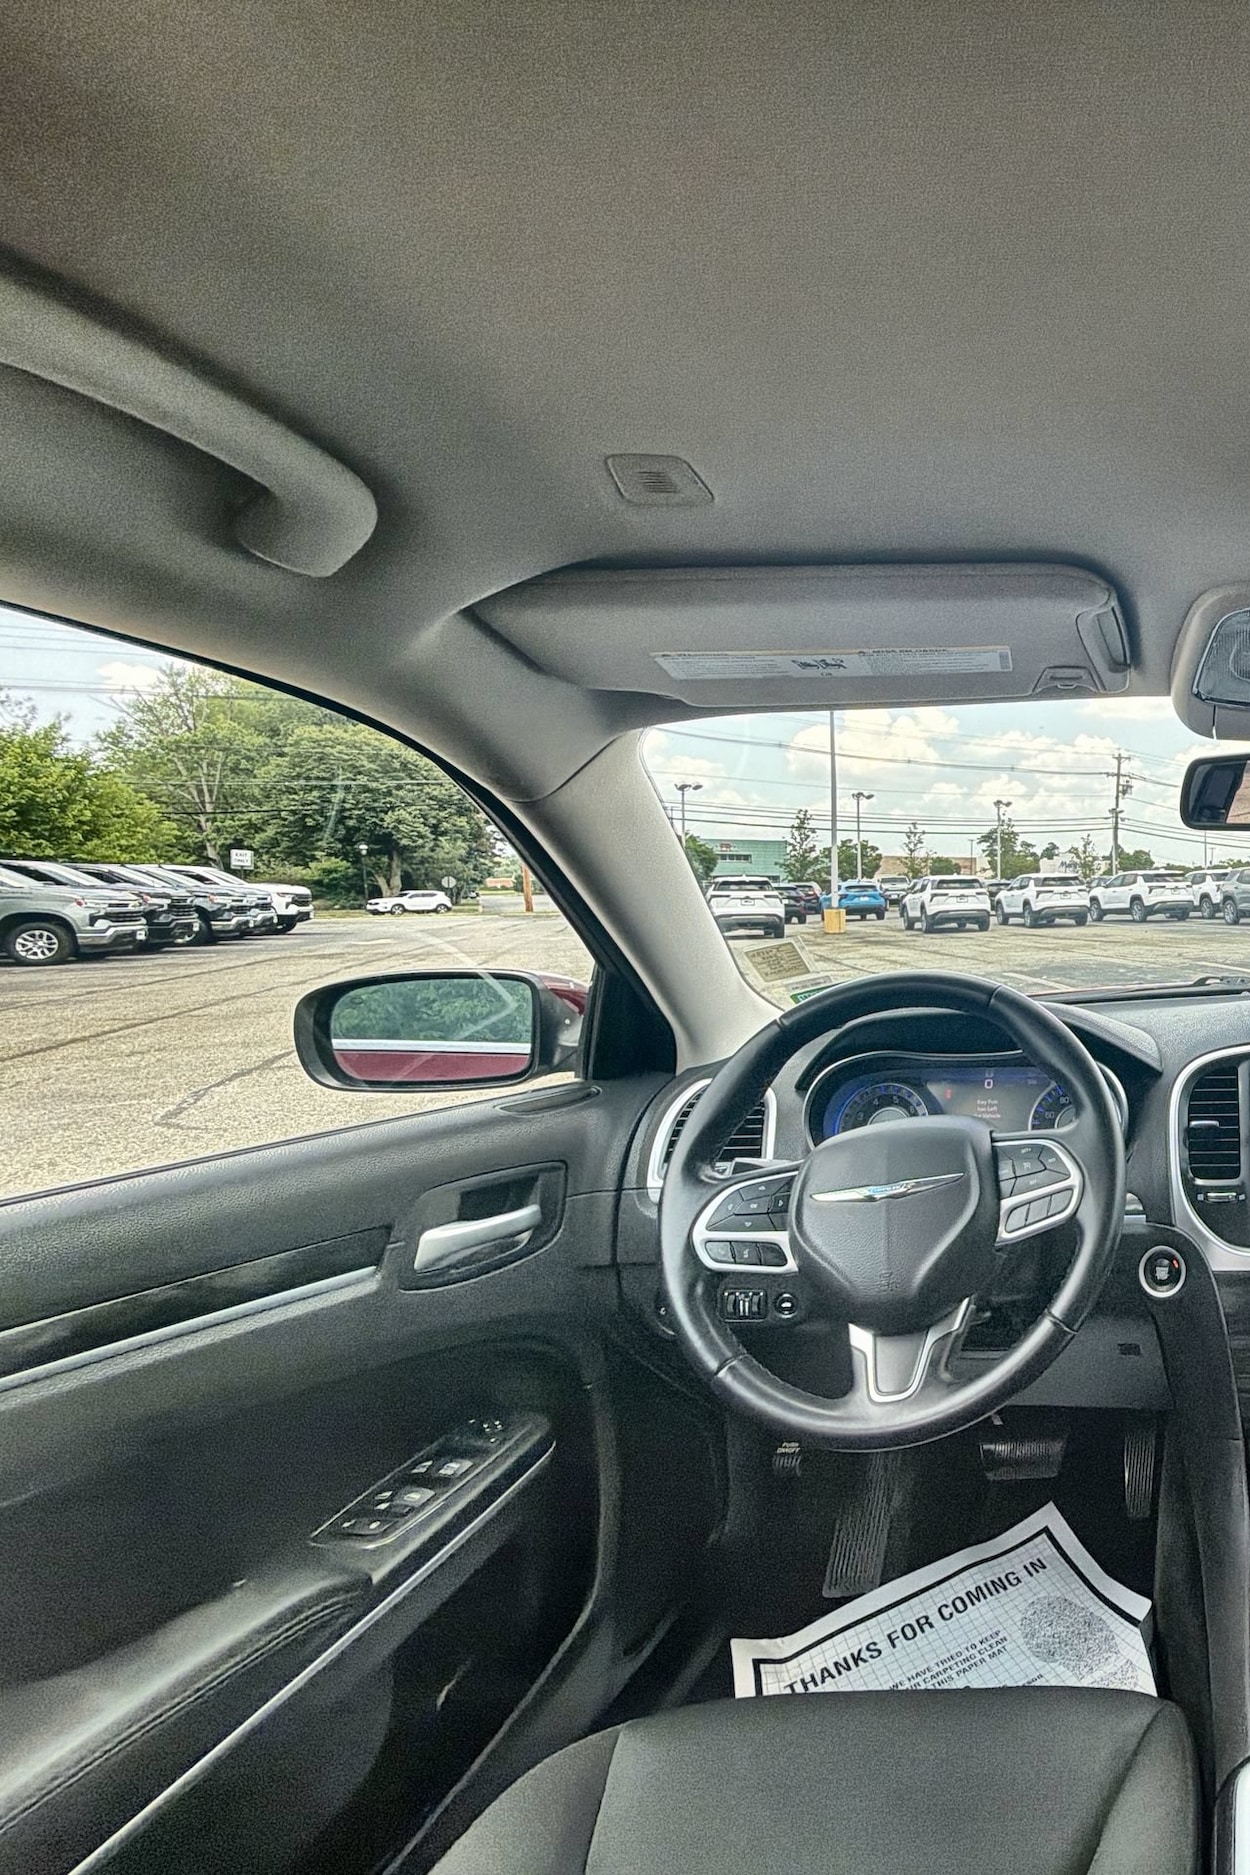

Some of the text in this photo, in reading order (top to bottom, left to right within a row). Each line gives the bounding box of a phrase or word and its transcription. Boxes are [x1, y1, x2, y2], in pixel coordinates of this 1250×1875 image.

[784, 1557, 1047, 1693] THANKS FOR COMING IN
[907, 1666, 933, 1682] HAVE
[935, 1651, 963, 1669] TRIED
[964, 1643, 977, 1655] TO
[978, 1630, 1001, 1645] KEEP
[923, 1652, 977, 1684] CARPETING
[979, 1636, 1008, 1656] CLEAN
[931, 1645, 1008, 1689] THIS PAPER MAT
